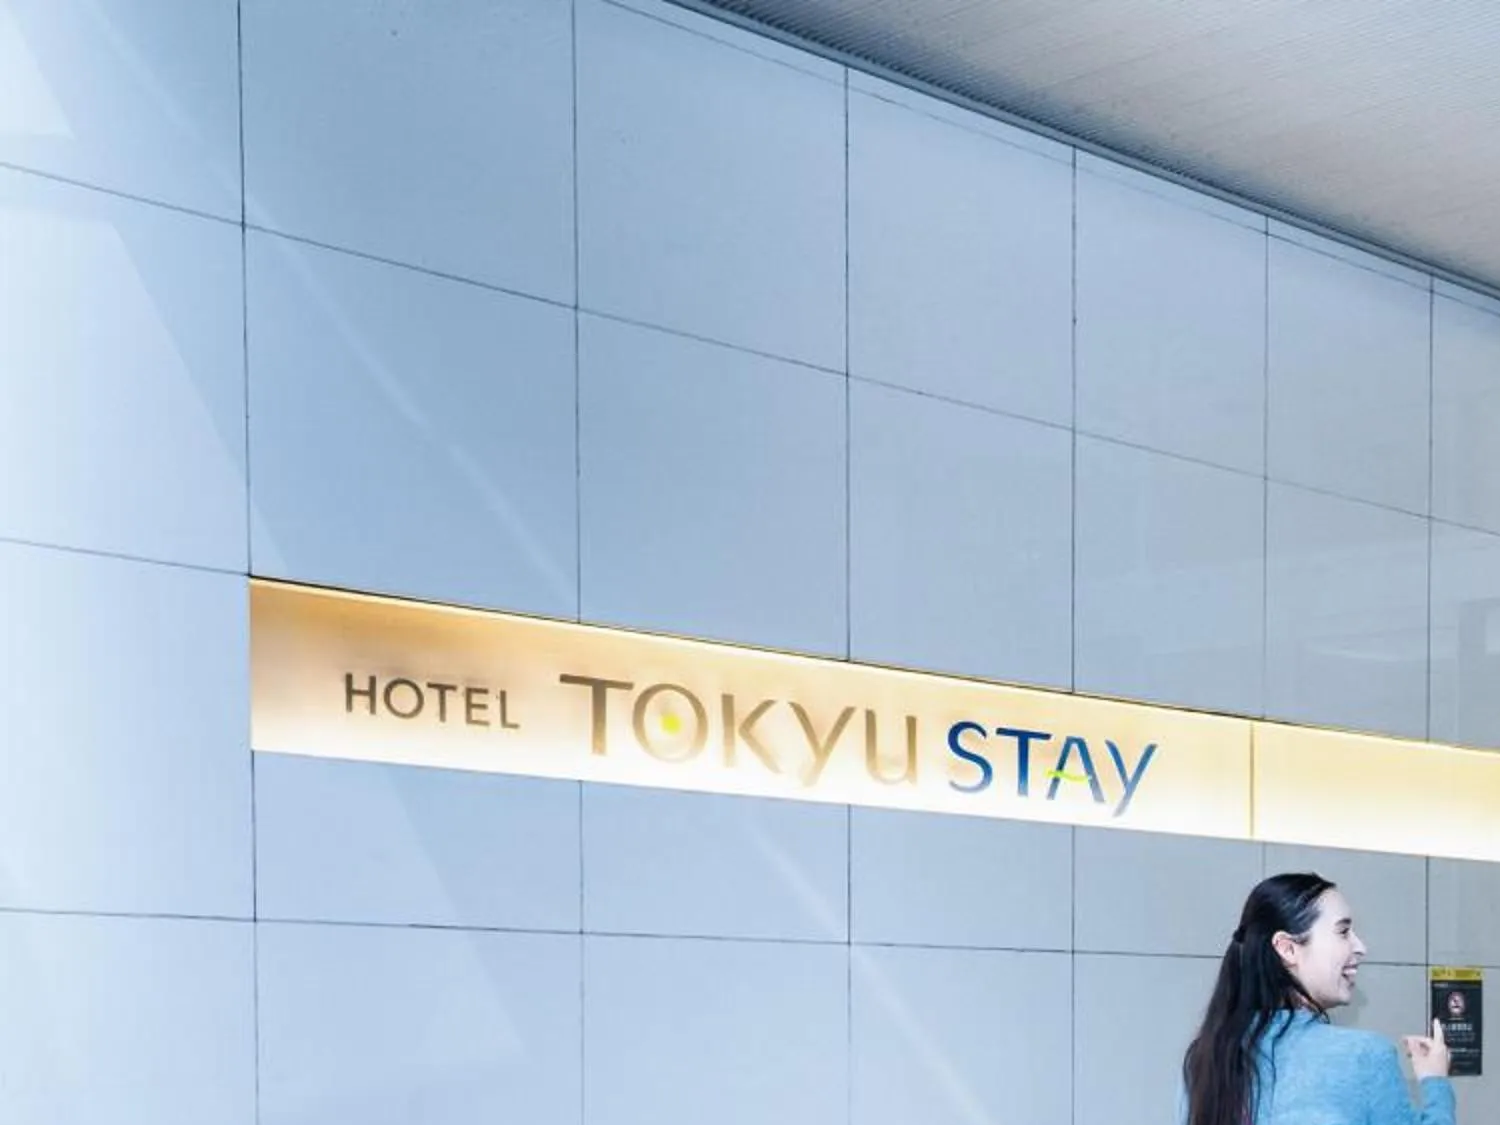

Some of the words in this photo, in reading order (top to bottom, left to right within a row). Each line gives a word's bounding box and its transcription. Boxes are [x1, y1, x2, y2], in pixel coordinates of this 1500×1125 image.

[345, 673, 520, 729] HOTEL
[559, 673, 918, 787] TOKYU
[947, 721, 1158, 818] STAY
